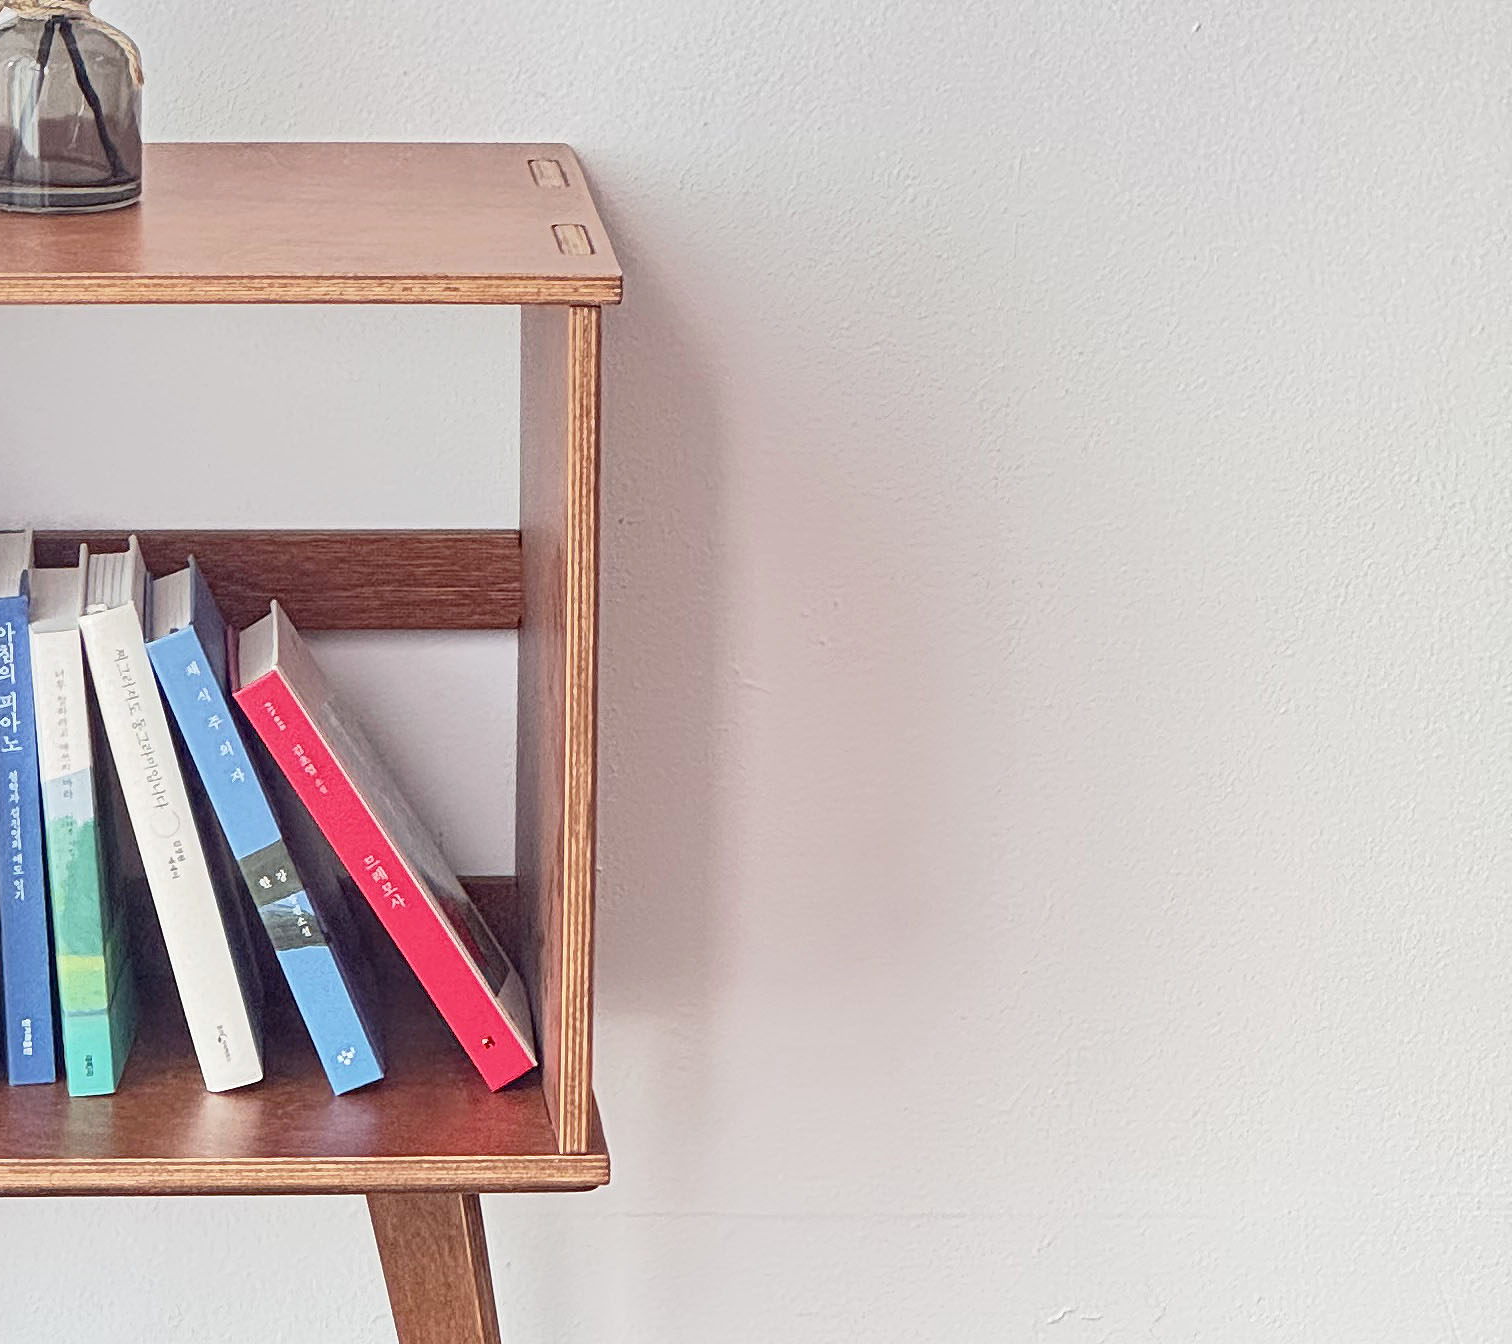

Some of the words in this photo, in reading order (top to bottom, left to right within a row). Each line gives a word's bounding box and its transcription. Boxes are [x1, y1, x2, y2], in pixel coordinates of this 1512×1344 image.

[0, 691, 24, 753] 피아노
[131, 718, 169, 809] 동그라미입니다
[186, 660, 246, 784] 채식주의자
